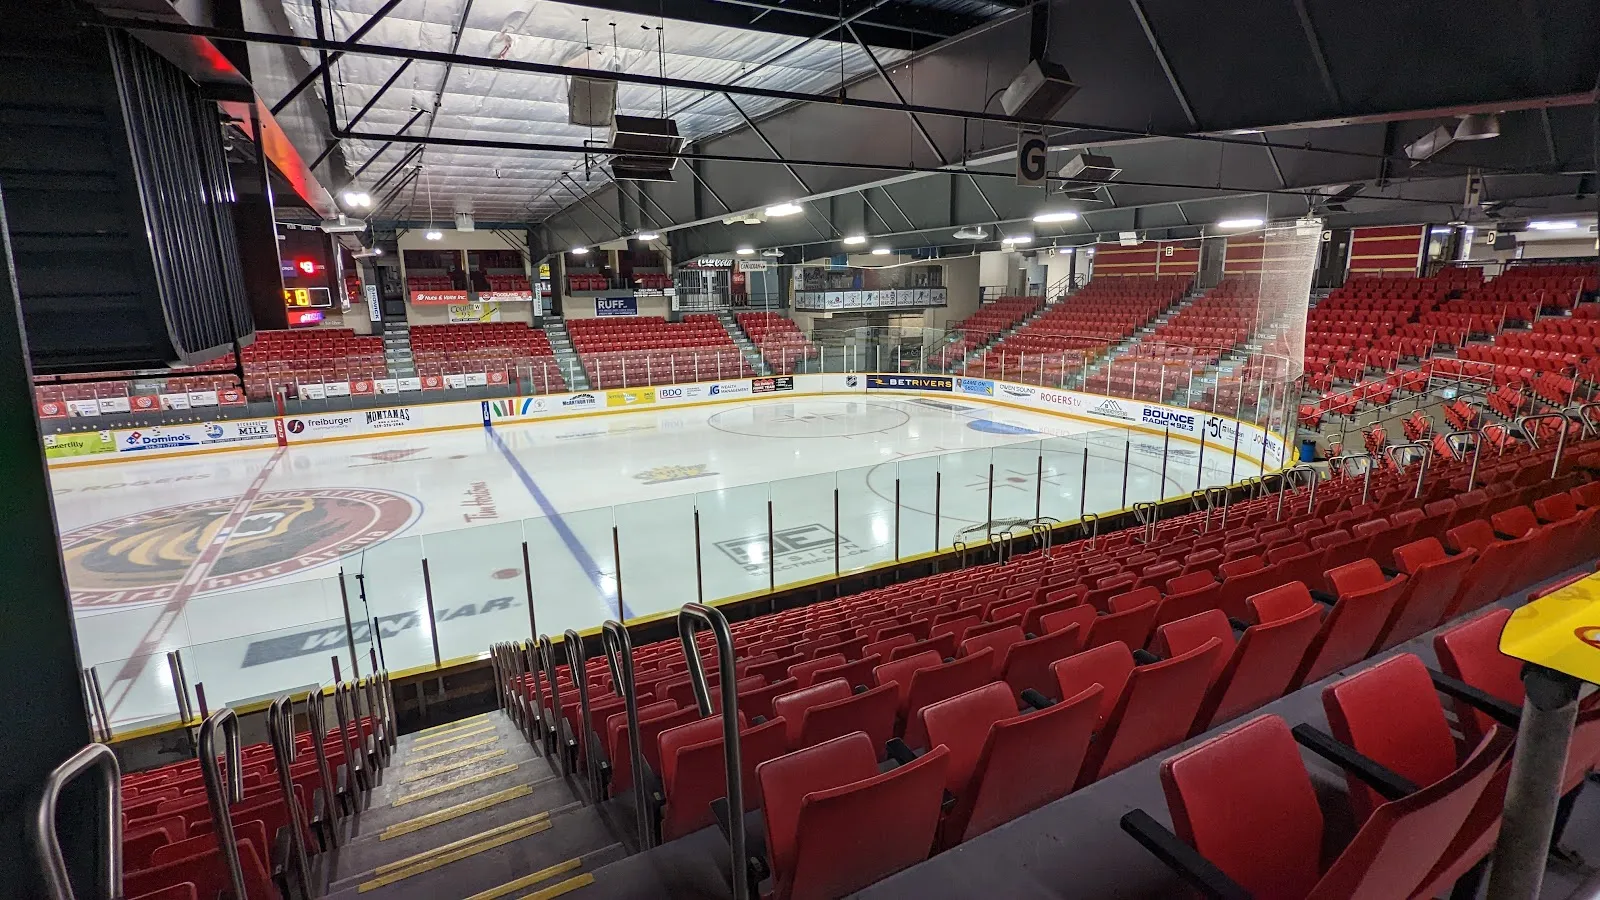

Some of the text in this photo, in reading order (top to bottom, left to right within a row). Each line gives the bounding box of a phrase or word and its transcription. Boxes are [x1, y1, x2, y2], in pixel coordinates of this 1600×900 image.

[1020, 138, 1047, 181] G
[1322, 231, 1330, 241] C
[1488, 232, 1495, 243] D
[1166, 247, 1173, 256] B
[371, 292, 380, 319] HOWICK
[598, 300, 625, 309] RUFF
[889, 378, 952, 388] BETRIVERS
[662, 388, 682, 397] BDO
[709, 384, 720, 396] IG
[1016, 386, 1036, 394] SOUND
[1040, 392, 1072, 406] ROGERS
[1073, 397, 1082, 407] tv
[308, 416, 353, 427] freiburger
[365, 408, 410, 425] MONTANA'S
[1142, 408, 1195, 425] BOUNCE
[1142, 416, 1194, 432] RADIO 92.3
[238, 426, 268, 435] MILK
[142, 433, 191, 444] Domino's
